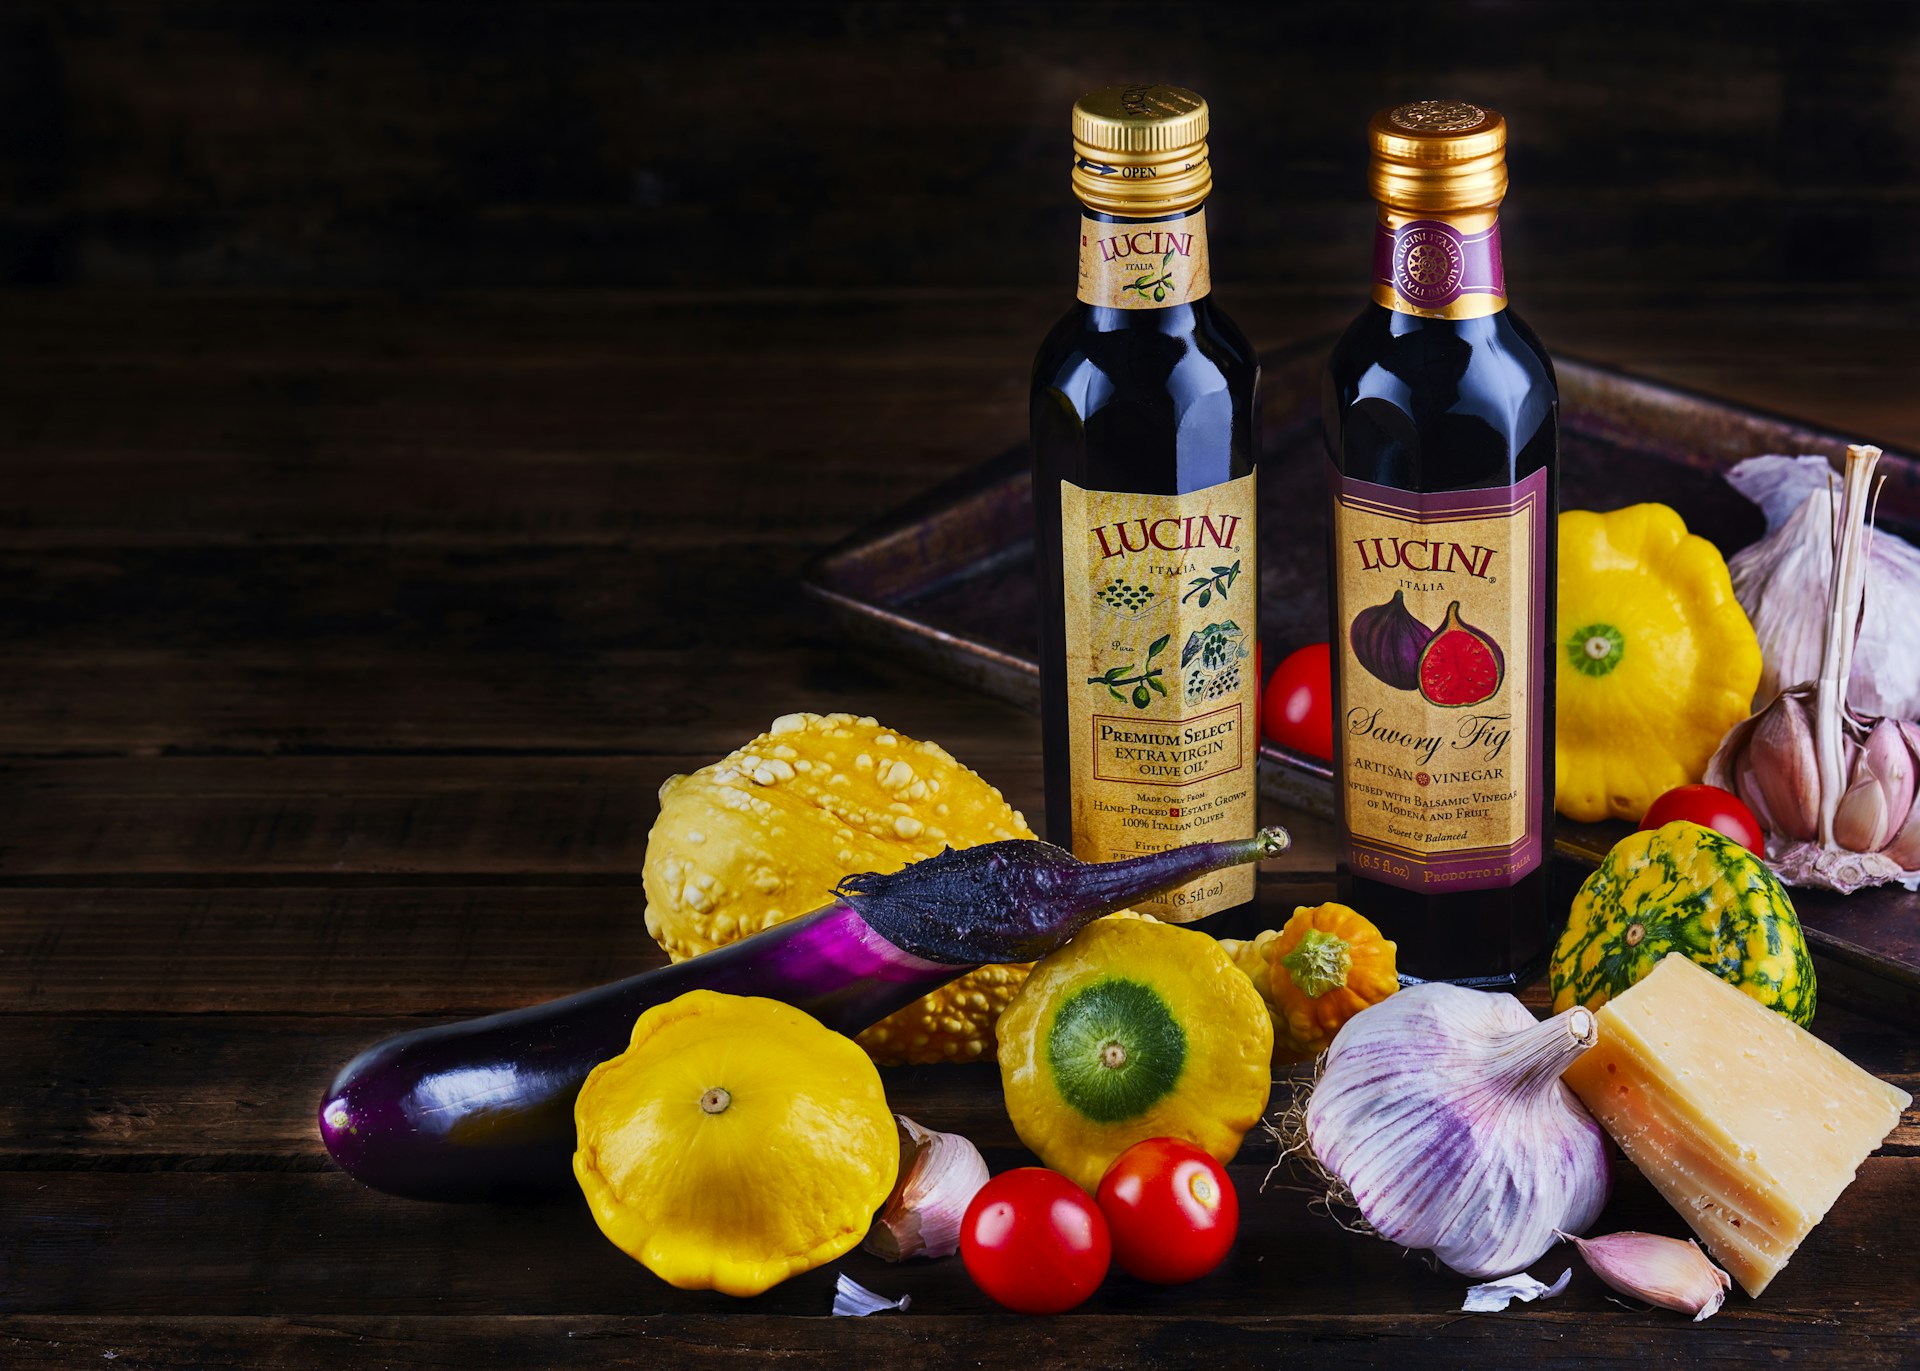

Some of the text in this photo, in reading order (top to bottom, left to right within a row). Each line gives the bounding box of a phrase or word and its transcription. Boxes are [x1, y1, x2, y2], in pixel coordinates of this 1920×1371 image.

[1122, 167, 1157, 179] OPEN
[1097, 230, 1195, 263] LUCINI
[1397, 232, 1460, 264] LUCINI ITALIA
[1125, 262, 1154, 272] ITALIA
[1149, 563, 1196, 575] ITALIA
[1399, 579, 1445, 592] ITALIA
[1100, 719, 1236, 747] PREMIUM SELECT
[1346, 706, 1513, 767] Savory Fig
[1115, 739, 1225, 763] EXTRA VIRGIN
[1139, 764, 1181, 777] OLIVE
[1354, 757, 1504, 785] ARTISAN VINEGAR
[1137, 791, 1206, 805] MADE ONLY FROM
[1180, 801, 1213, 818] ESTATE
[1215, 790, 1248, 807] GROWN
[1385, 790, 1412, 804] WITH
[1413, 795, 1470, 809] BALSAMIC
[1473, 790, 1518, 803] VINEGAR
[1367, 799, 1491, 822] OF MODENA AND FRUIT
[1121, 811, 1225, 832] 100% ITALIAN OLIVES
[1387, 824, 1468, 843] Sweet & Balanced
[1135, 841, 1161, 851] First
[1358, 852, 1380, 870] (8.5
[1382, 858, 1393, 873] fl
[1392, 866, 1411, 881] oz)
[1424, 867, 1491, 883] PRODOTTO
[1206, 881, 1224, 896] oz)
